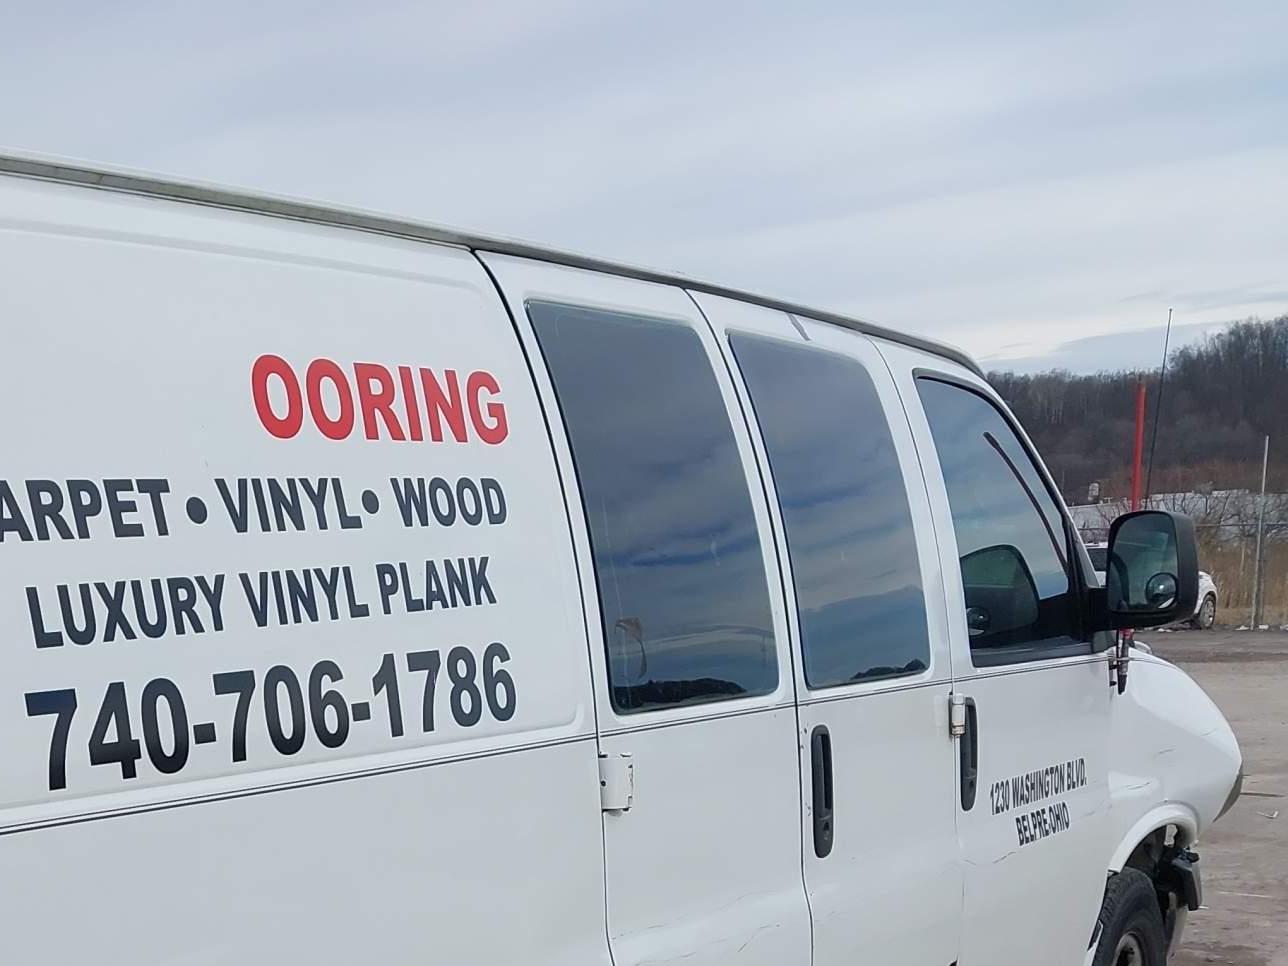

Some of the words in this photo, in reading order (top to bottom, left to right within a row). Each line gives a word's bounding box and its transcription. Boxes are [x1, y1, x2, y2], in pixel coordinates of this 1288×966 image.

[251, 354, 509, 445] OORING
[390, 477, 508, 528] WOOD
[25, 574, 225, 649] LUXURY
[239, 566, 370, 628] VINYL
[376, 556, 497, 615] PLANK
[24, 642, 517, 791] 740-706-1786
[990, 779, 1010, 815] 1230
[1012, 764, 1065, 808] WASHINGTON
